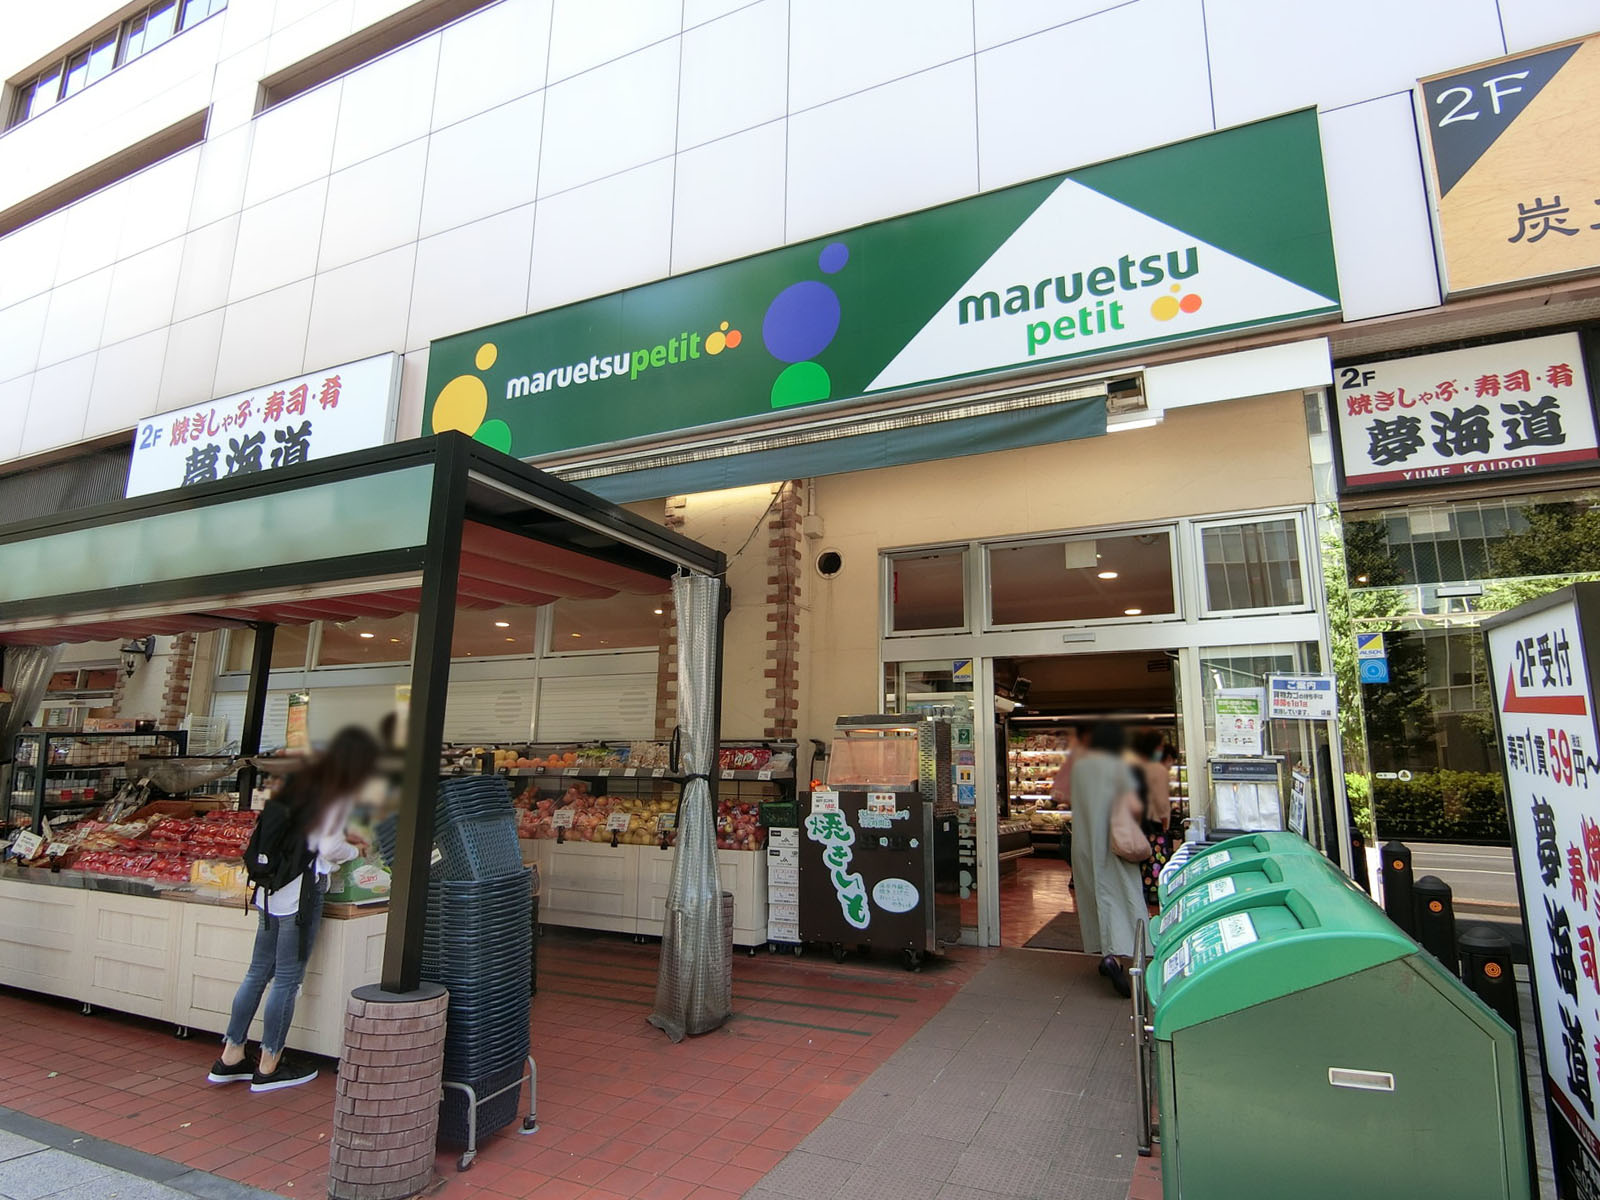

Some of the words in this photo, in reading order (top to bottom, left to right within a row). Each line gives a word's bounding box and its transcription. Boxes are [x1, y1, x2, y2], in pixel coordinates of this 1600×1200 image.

[1436, 70, 1530, 128] 2F
[1508, 195, 1600, 243] 炭
[958, 246, 1199, 326] maruetsu
[1026, 300, 1125, 356] petit
[1340, 368, 1376, 390] 2F
[139, 424, 163, 450] 2F
[1365, 395, 1566, 467] 夢海道
[1516, 628, 1572, 688] 2F受付
[810, 813, 866, 923] 焼きいも
[1531, 793, 1595, 1121] 夢海道
